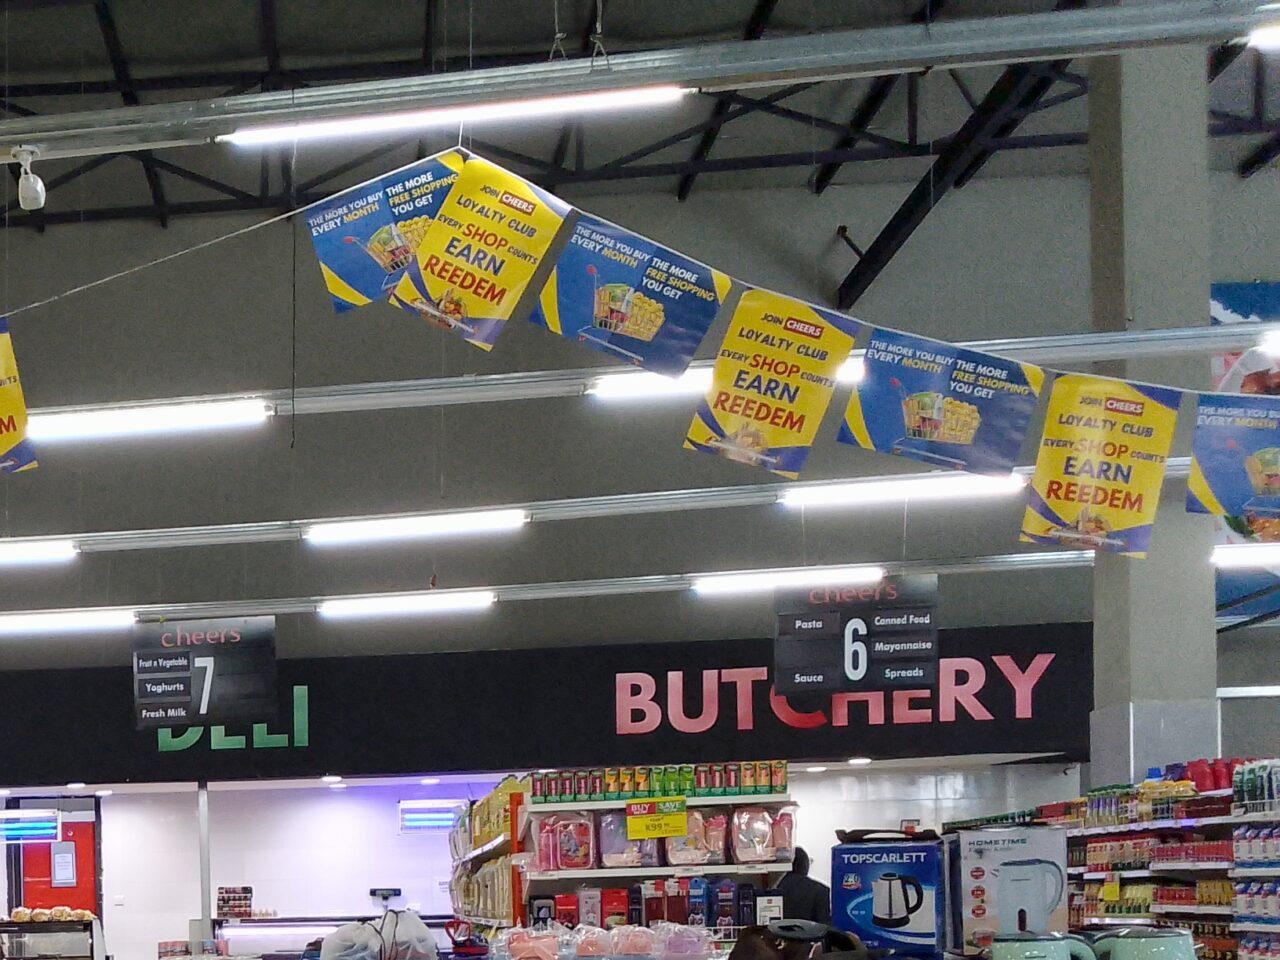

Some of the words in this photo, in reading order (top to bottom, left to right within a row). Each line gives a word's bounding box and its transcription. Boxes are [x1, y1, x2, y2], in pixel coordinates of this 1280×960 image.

[386, 184, 402, 196] THE
[405, 172, 433, 190] MORE
[388, 191, 411, 206] FREE
[412, 174, 458, 197] SHOPPING
[480, 185, 499, 196] JOIN
[502, 194, 533, 213] CHEERS
[456, 195, 505, 224] LOYALTY
[508, 219, 537, 238] CLUB
[438, 214, 463, 228] EVERY
[463, 223, 508, 250] SHOP
[507, 245, 538, 264] COUNTS
[571, 235, 603, 253] EVERY
[602, 248, 638, 268] MONTH
[576, 226, 590, 239] THE
[591, 232, 615, 247] MORE
[616, 241, 633, 253] YOU
[633, 247, 650, 261] BUY
[445, 237, 506, 276] EARN
[652, 258, 669, 271] THE
[670, 264, 698, 282] MORE
[423, 254, 507, 306] REEDEM
[642, 278, 664, 293] YOU
[663, 286, 682, 299] GET
[645, 267, 668, 282] FREE
[668, 275, 714, 302] SHOPPING
[761, 313, 783, 325] JOIN
[786, 320, 822, 337] CHEERS
[738, 327, 794, 351] LOYALTY
[797, 344, 828, 360] CLUB
[720, 349, 749, 363] EVERY
[749, 354, 801, 378] SHOP
[801, 372, 834, 387] COUNTS
[733, 370, 800, 403] EARN
[950, 381, 972, 394] YOU
[974, 387, 995, 399] GET
[952, 371, 976, 383] FREE
[977, 376, 1029, 396] SHOPPING
[713, 391, 806, 433] REEDEM
[1078, 439, 1128, 458] SHOP
[1064, 457, 1133, 484] EARN
[1046, 480, 1143, 513] REEDEM
[796, 620, 822, 629] Pasta
[875, 616, 906, 625] Canned
[910, 615, 930, 623] Food
[162, 627, 240, 647] cheers
[844, 618, 867, 680] 6
[875, 642, 932, 652] Mayonnaise
[194, 657, 214, 714] 7
[794, 674, 823, 682] Sauce
[885, 668, 923, 679] Spreads
[146, 683, 184, 693] Yoghurts
[142, 709, 165, 718] Fresh
[168, 709, 186, 717] Milk
[842, 853, 927, 864] TOPSCARLETT
